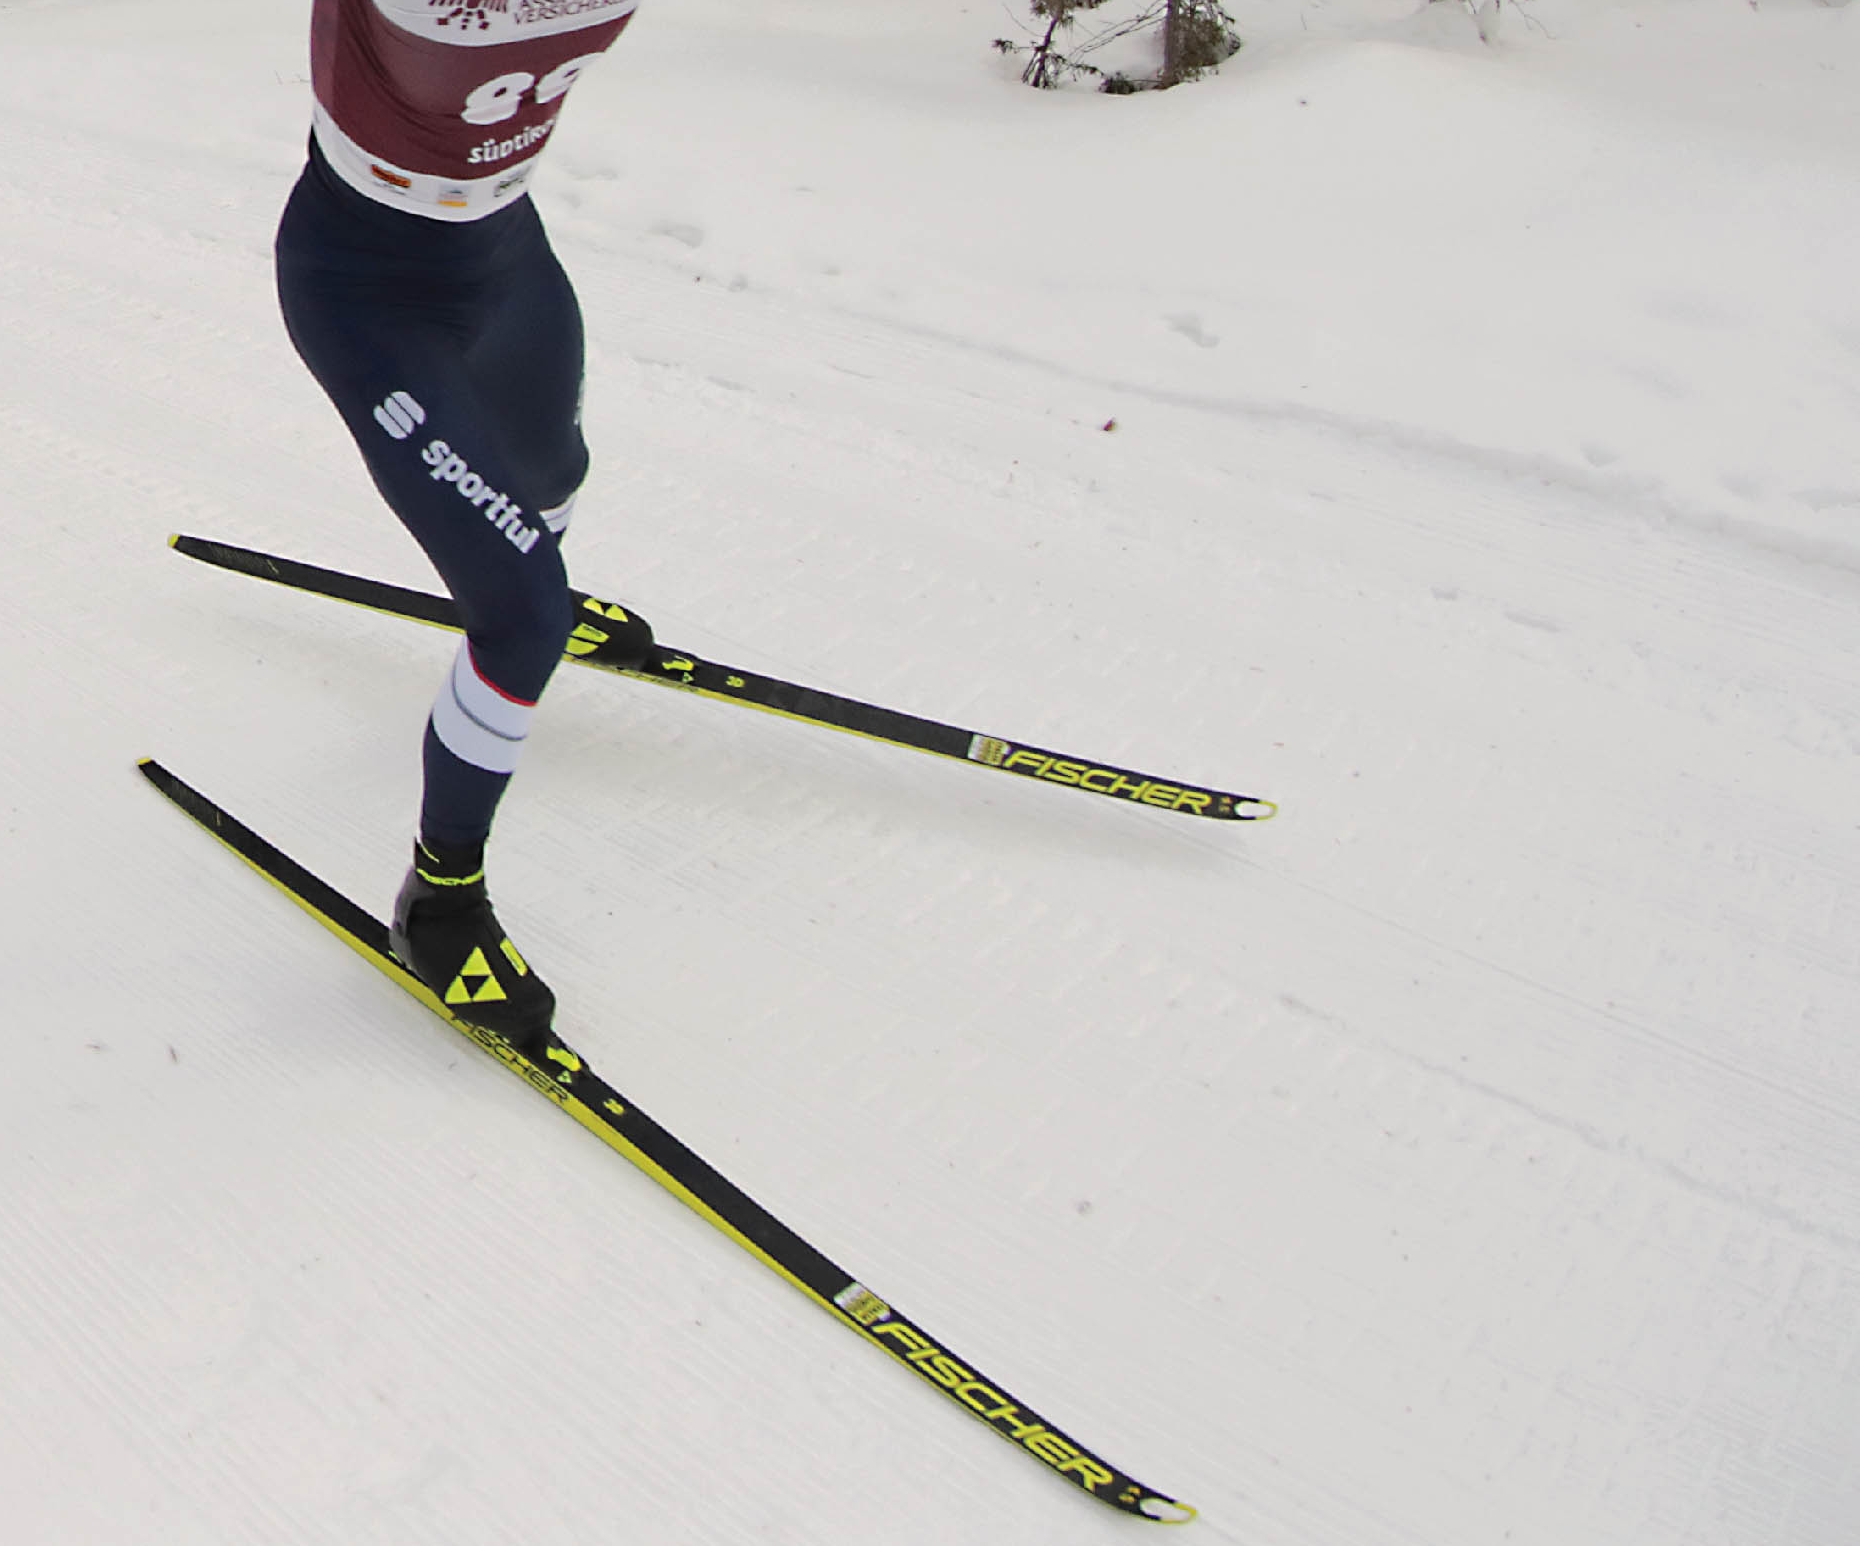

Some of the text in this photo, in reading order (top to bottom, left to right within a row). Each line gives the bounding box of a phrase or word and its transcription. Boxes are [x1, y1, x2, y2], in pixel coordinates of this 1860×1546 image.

[421, 439, 541, 554] sportful
[1003, 748, 1214, 816] FISCHER
[871, 1320, 1114, 1494] FISCHER
